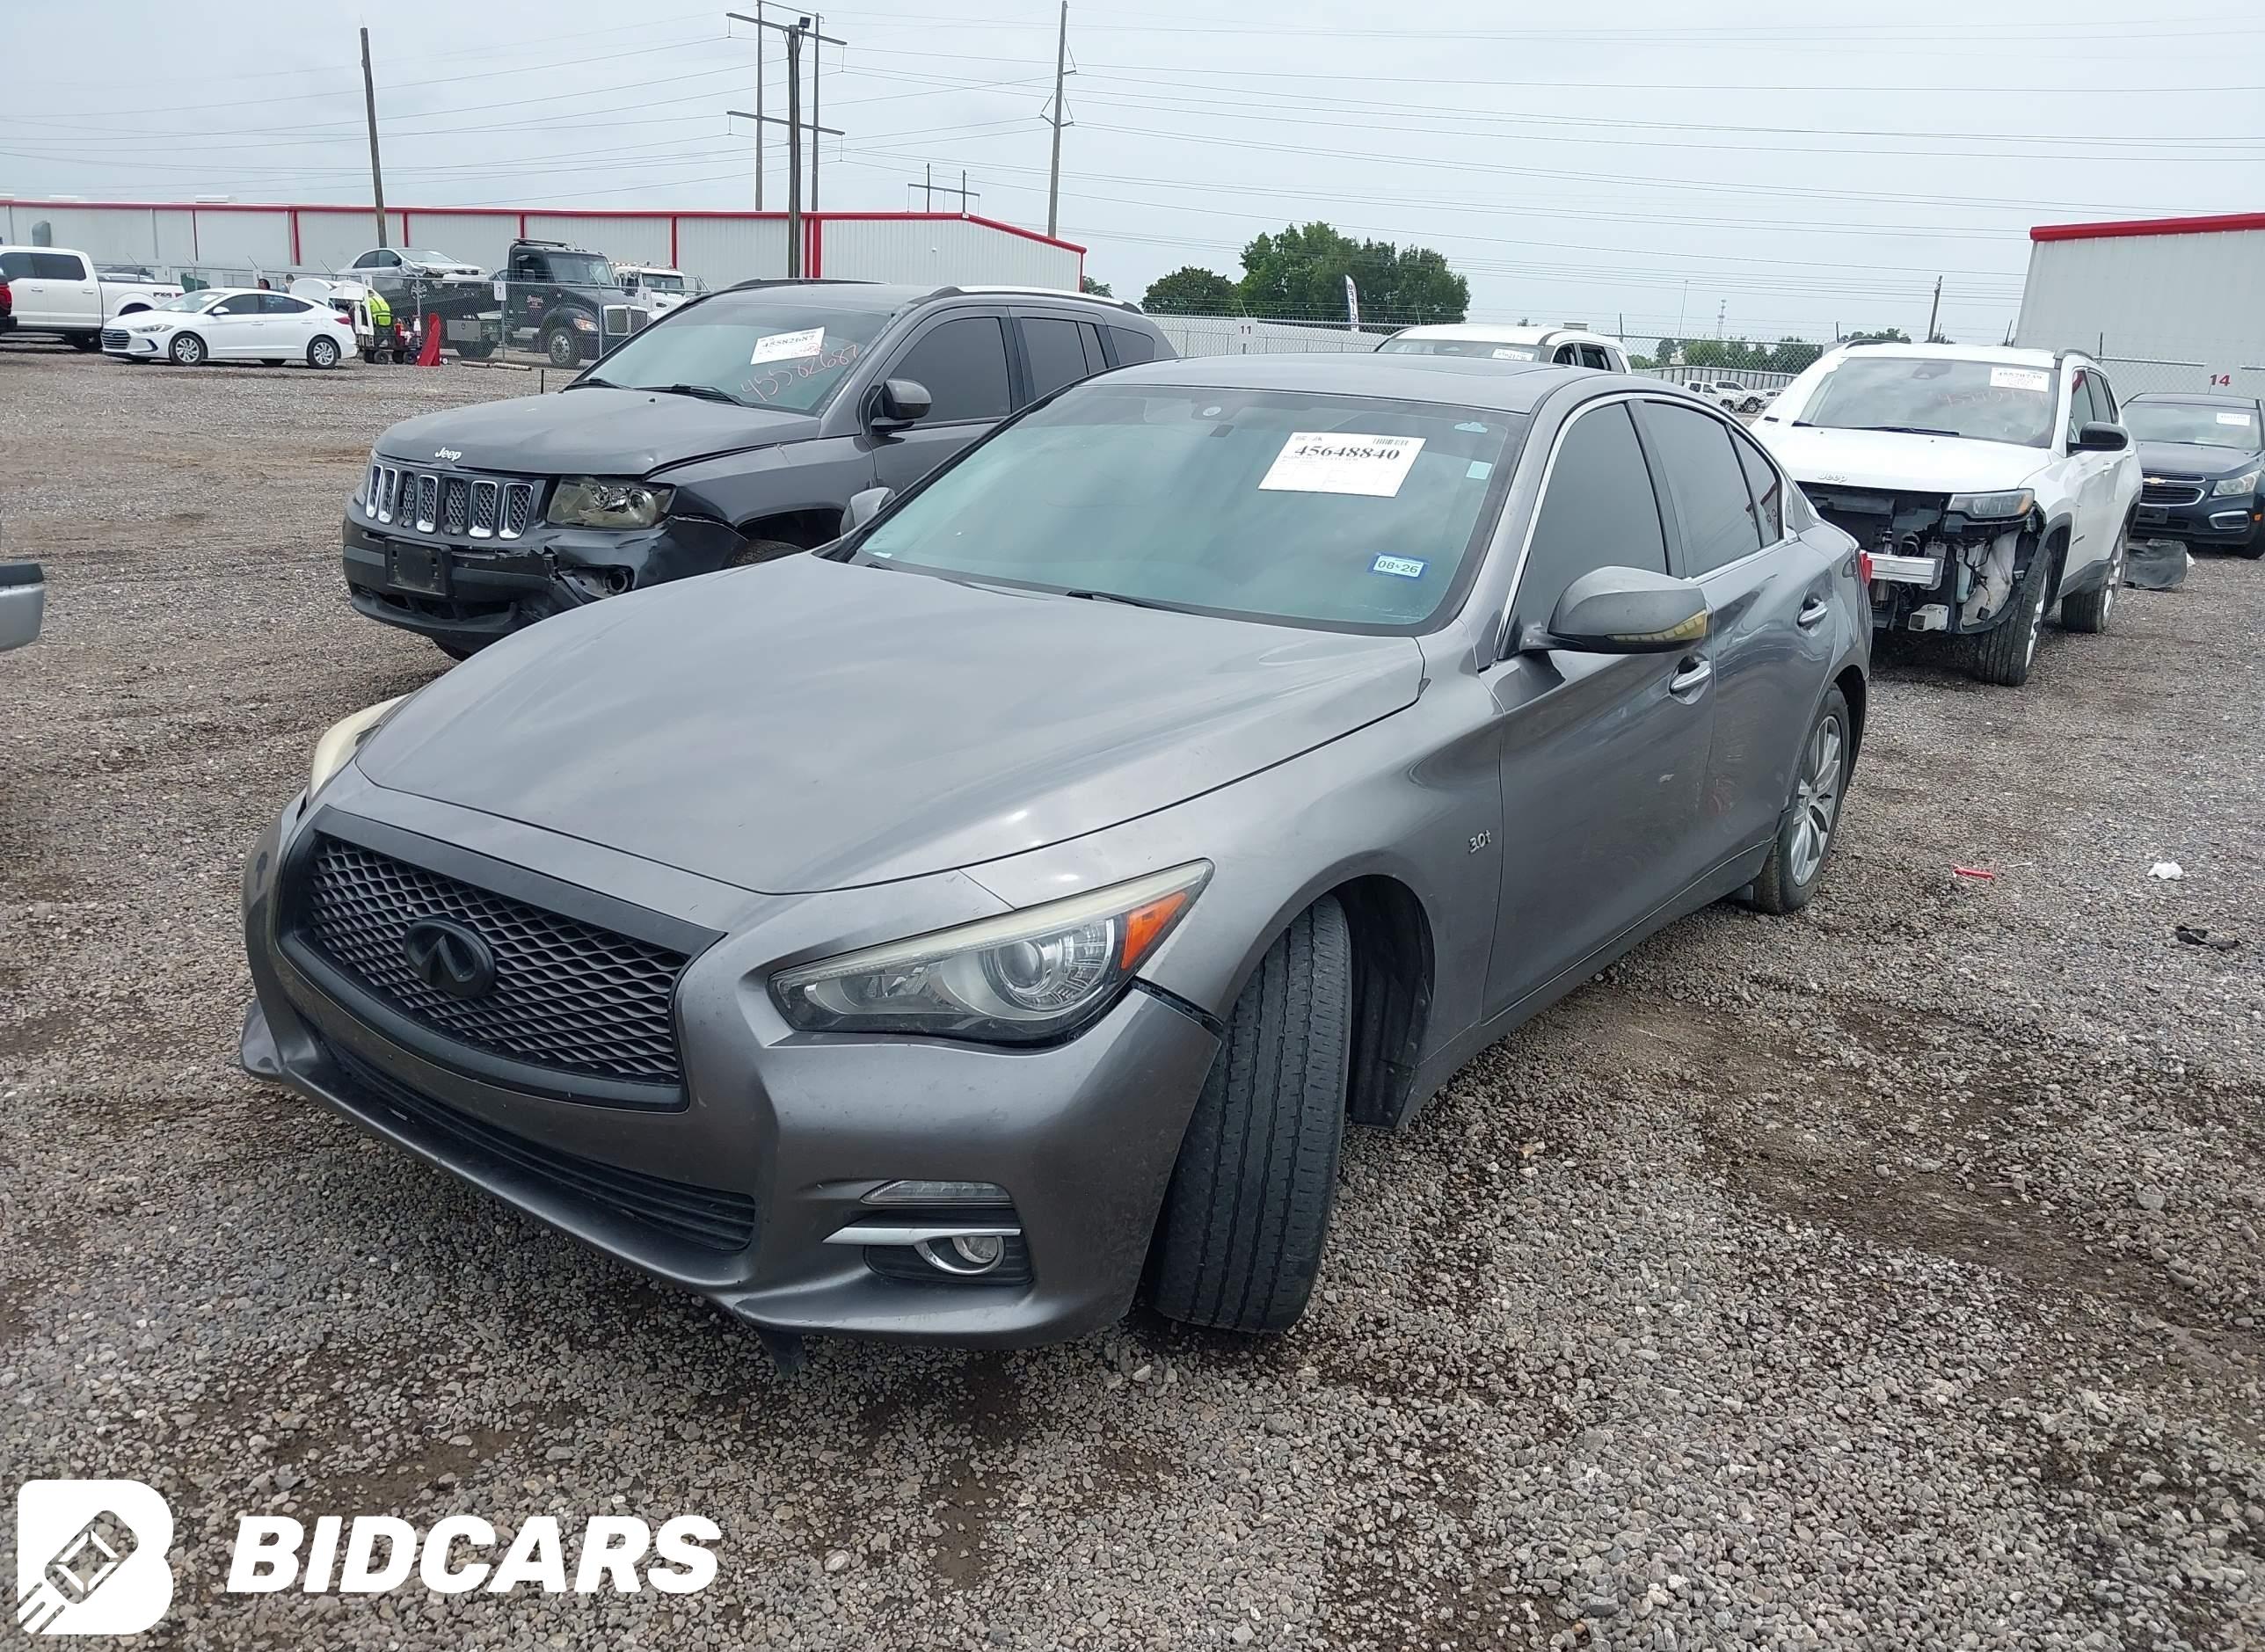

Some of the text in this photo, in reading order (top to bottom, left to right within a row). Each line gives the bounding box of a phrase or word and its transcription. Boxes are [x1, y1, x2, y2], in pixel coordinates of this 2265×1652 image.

[1240, 325, 1251, 335] 11
[2210, 374, 2231, 387] 14
[434, 447, 462, 462] Jeep
[1294, 445, 1400, 461] 45648840
[1817, 471, 1848, 484] Jeep
